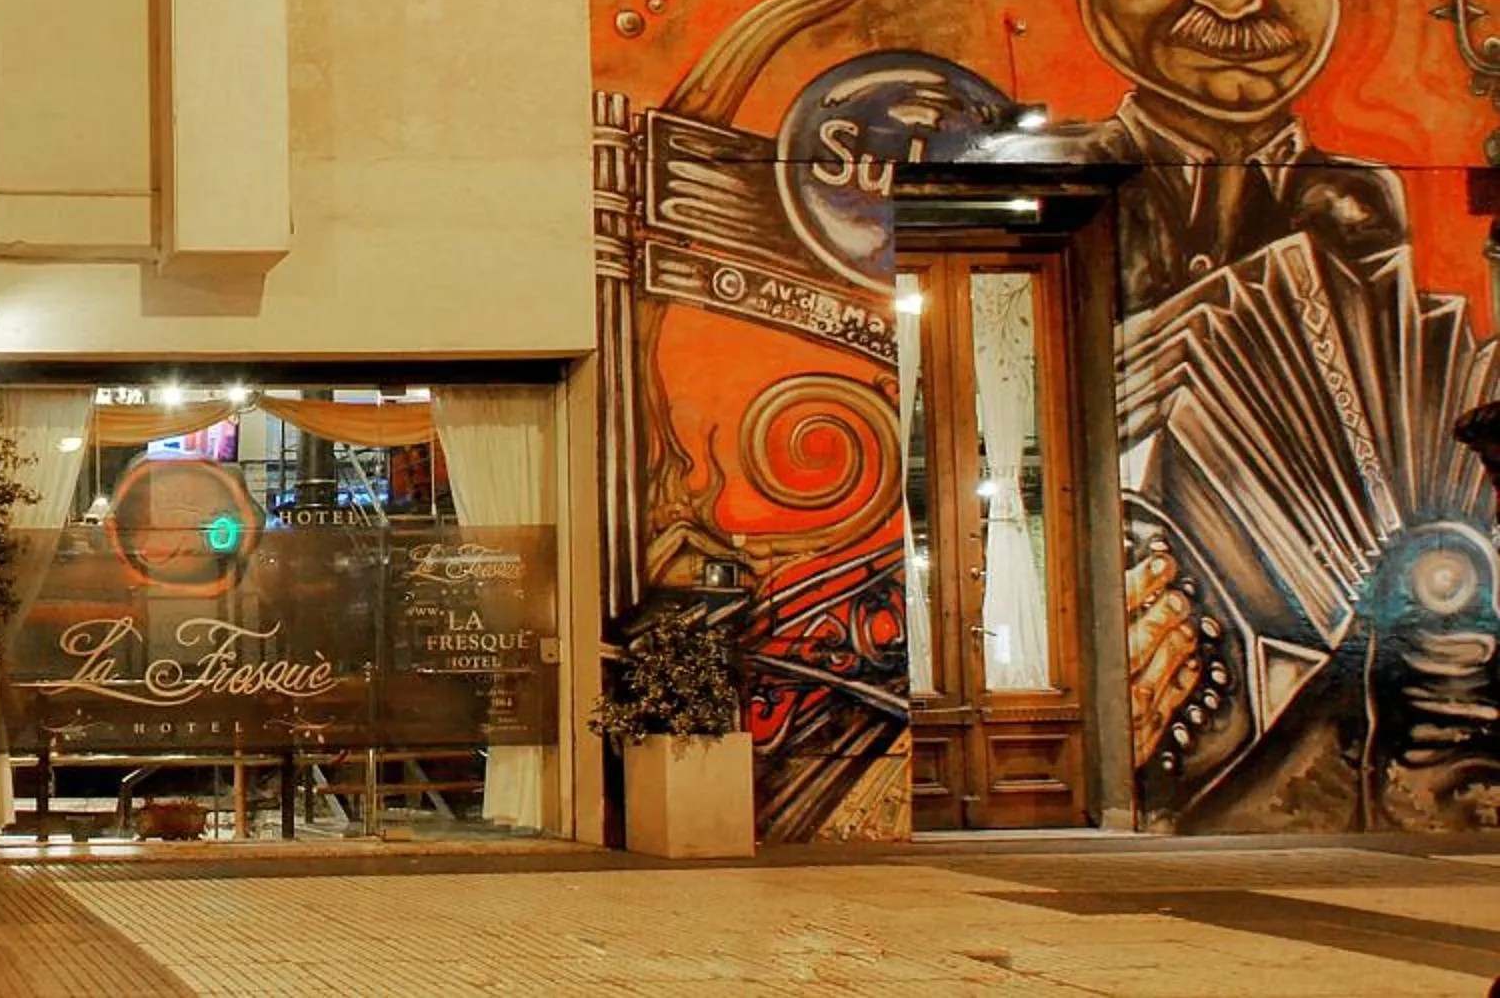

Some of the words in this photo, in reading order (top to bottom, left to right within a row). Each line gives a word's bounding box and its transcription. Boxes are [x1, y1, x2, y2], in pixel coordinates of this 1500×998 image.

[280, 510, 357, 525] HOTEL
[448, 610, 485, 631] LA
[133, 721, 244, 735] HOTEL
